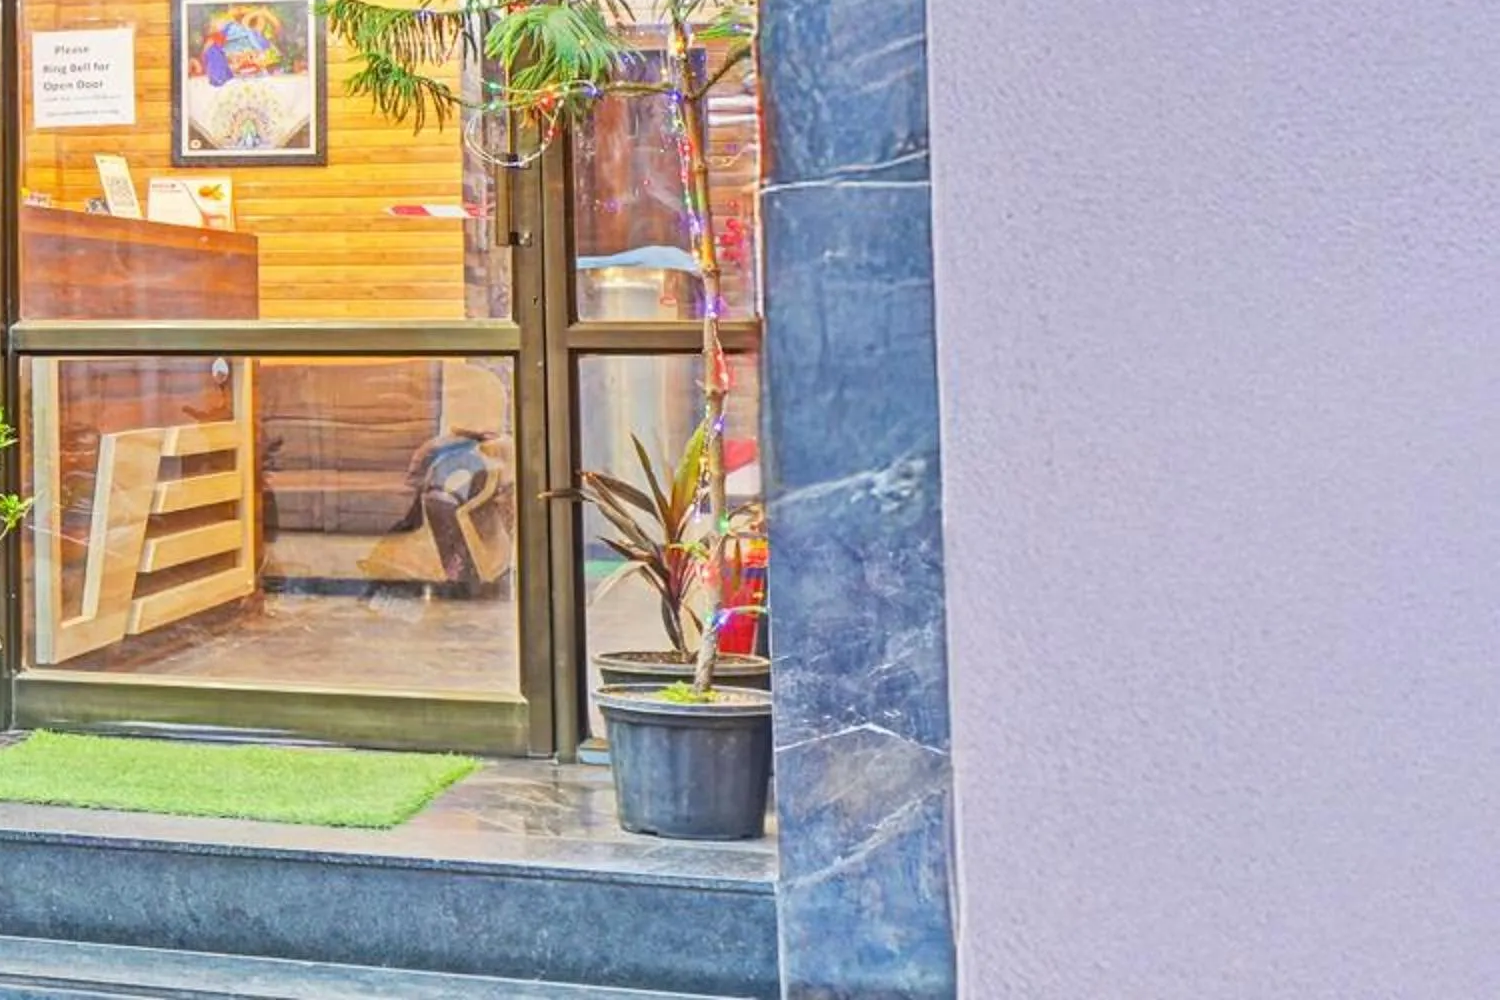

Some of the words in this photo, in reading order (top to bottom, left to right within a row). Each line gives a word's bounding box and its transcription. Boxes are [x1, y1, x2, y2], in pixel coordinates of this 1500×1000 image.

[54, 45, 90, 56] Please
[42, 63, 67, 75] Ring
[69, 62, 92, 73] Bell
[93, 61, 110, 72] for
[43, 81, 74, 92] Open
[76, 80, 104, 90] Door
